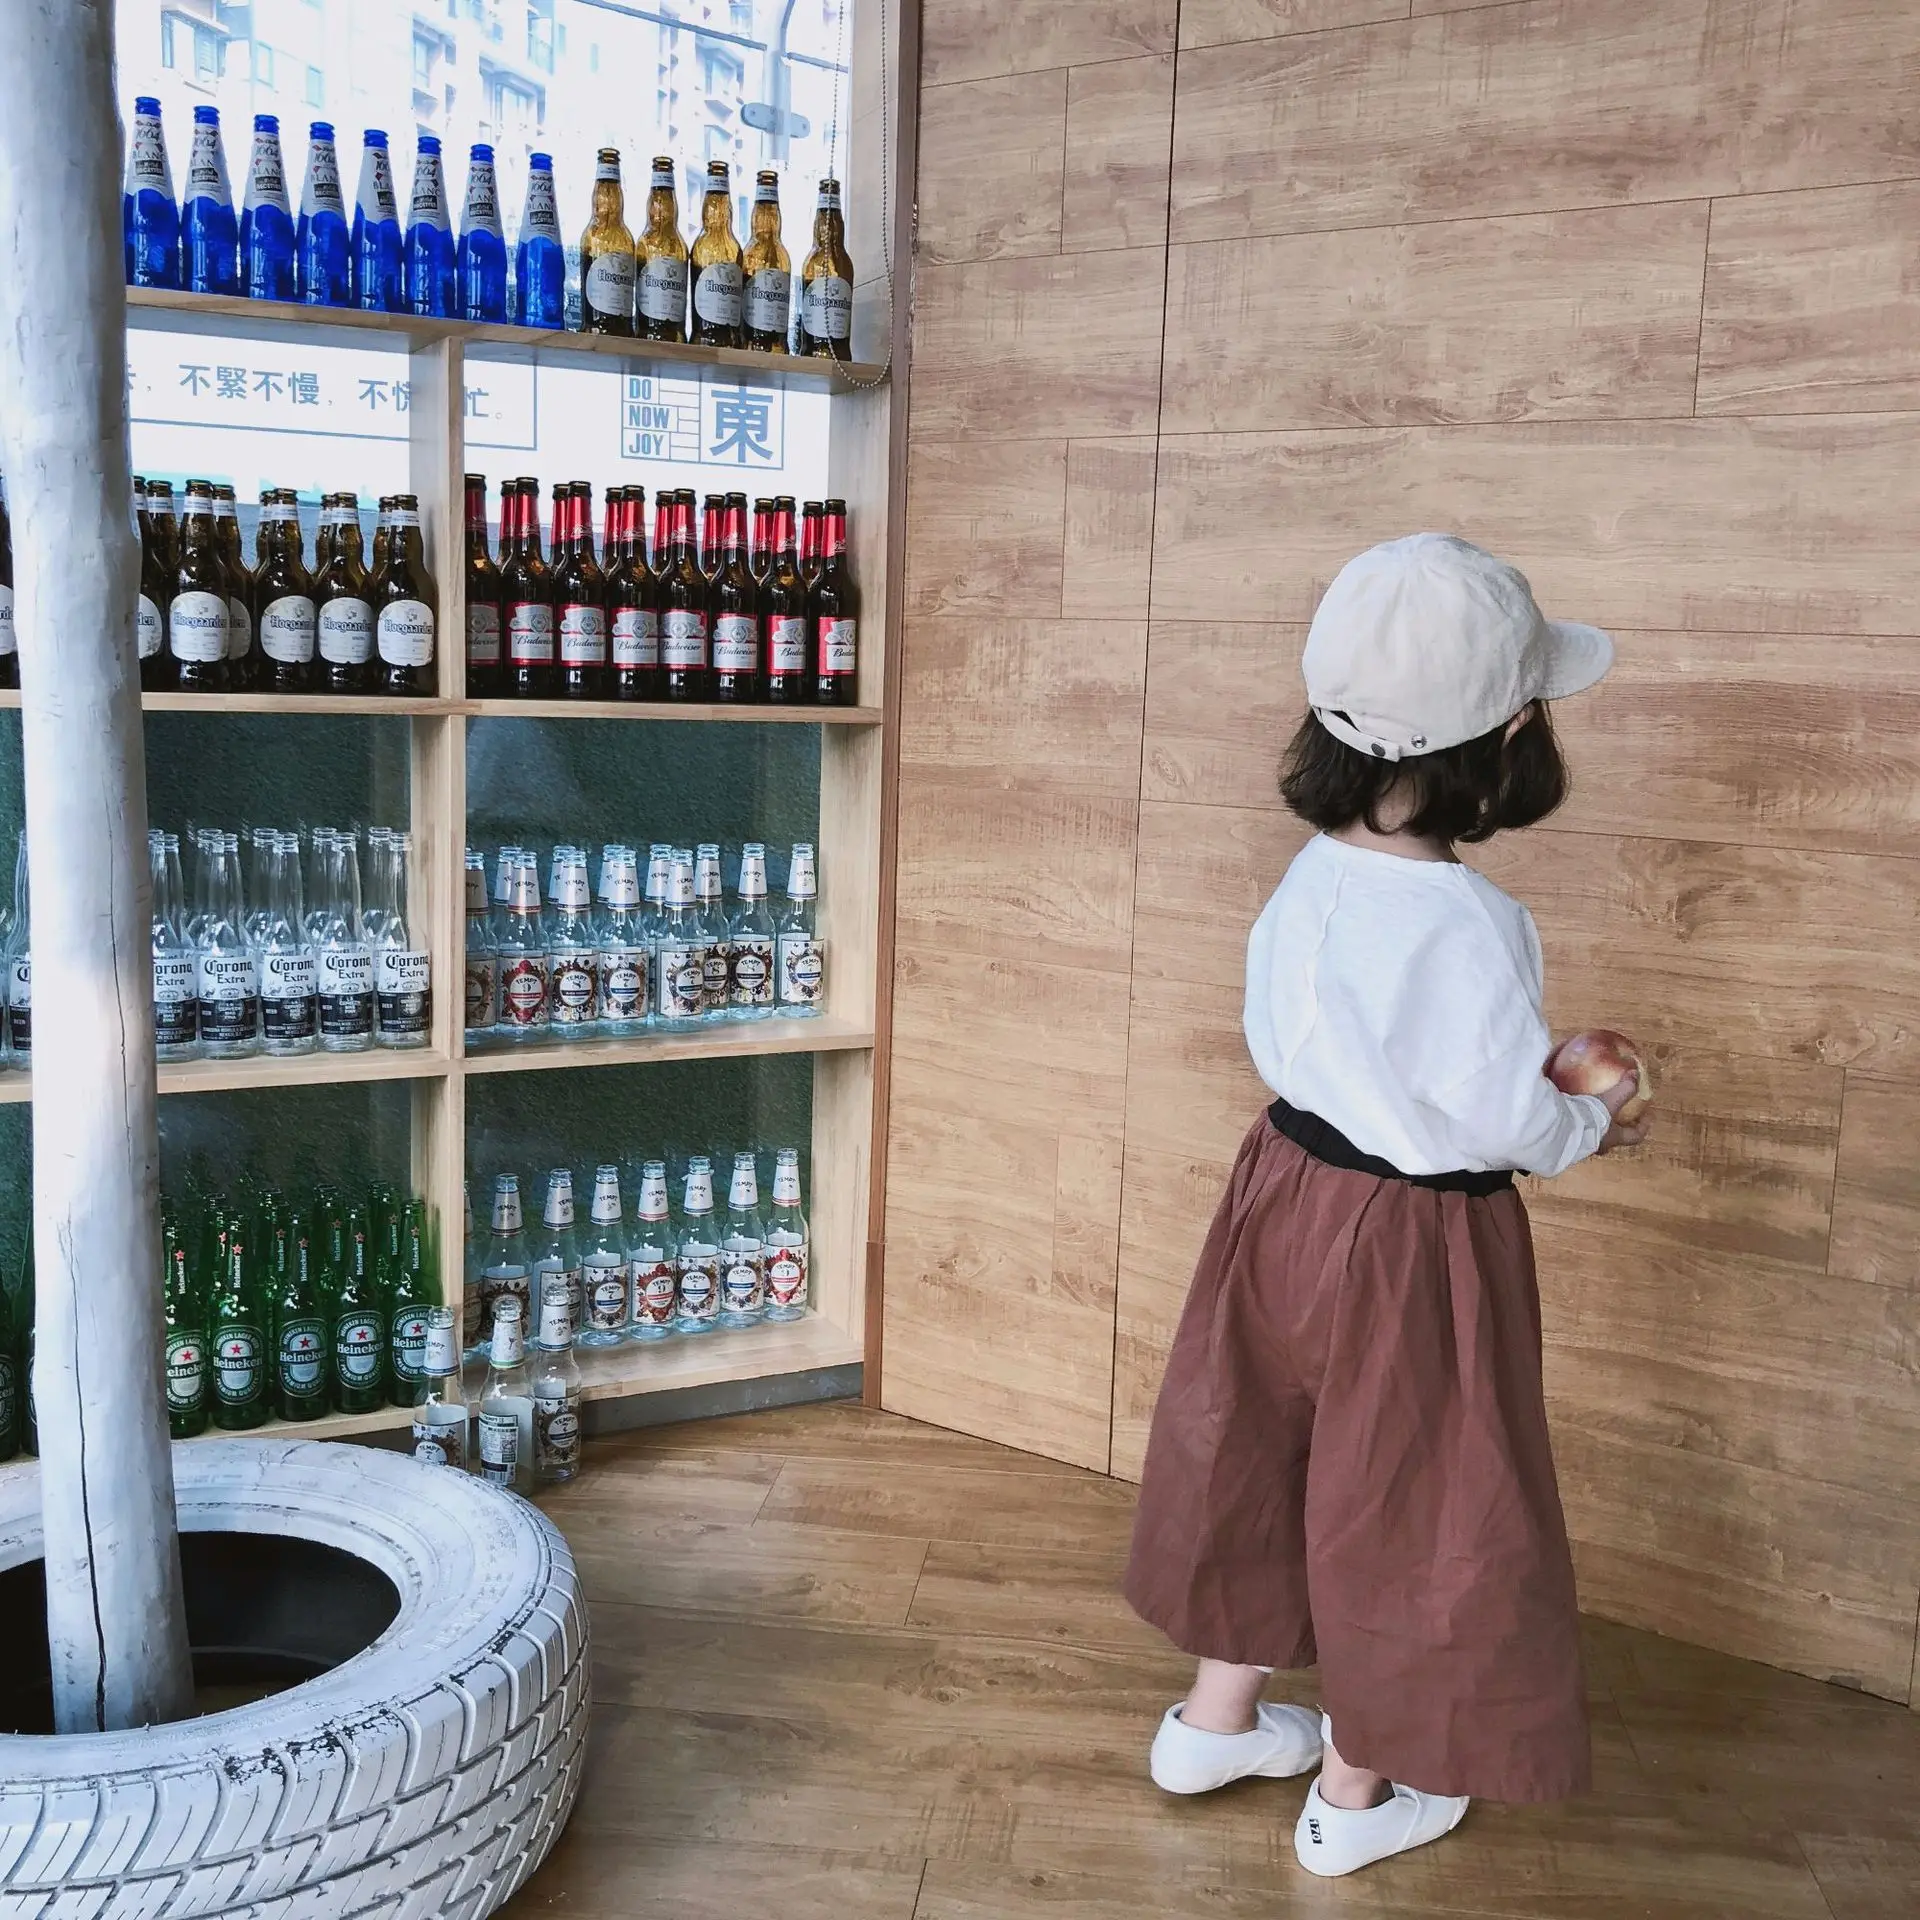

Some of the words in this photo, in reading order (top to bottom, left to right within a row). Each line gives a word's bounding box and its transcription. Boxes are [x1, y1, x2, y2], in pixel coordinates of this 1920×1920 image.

[629, 377, 652, 400] DO
[629, 405, 670, 429] NOW
[709, 384, 773, 463] 東
[629, 433, 664, 456] JOY
[661, 639, 701, 651] Budweiser
[514, 880, 536, 889] TEMPT
[204, 959, 255, 977] Corona
[270, 958, 314, 976] Corona
[326, 955, 372, 972] Corona
[386, 954, 429, 971] Corona
[706, 961, 723, 969] TEMPT
[802, 958, 819, 966] TEMPT
[155, 962, 194, 976] orona
[339, 969, 365, 979] Extra
[400, 968, 424, 978] Extra
[156, 975, 185, 987] Extra
[217, 973, 246, 984] Extra
[284, 972, 309, 982] Extra
[516, 978, 538, 986] TEMPT
[616, 972, 636, 980] TEMPT
[393, 1336, 427, 1348] Heine
[213, 1356, 263, 1369] Heineken
[555, 1417, 575, 1425] TEMPT
[418, 1444, 440, 1453] TEMPT
